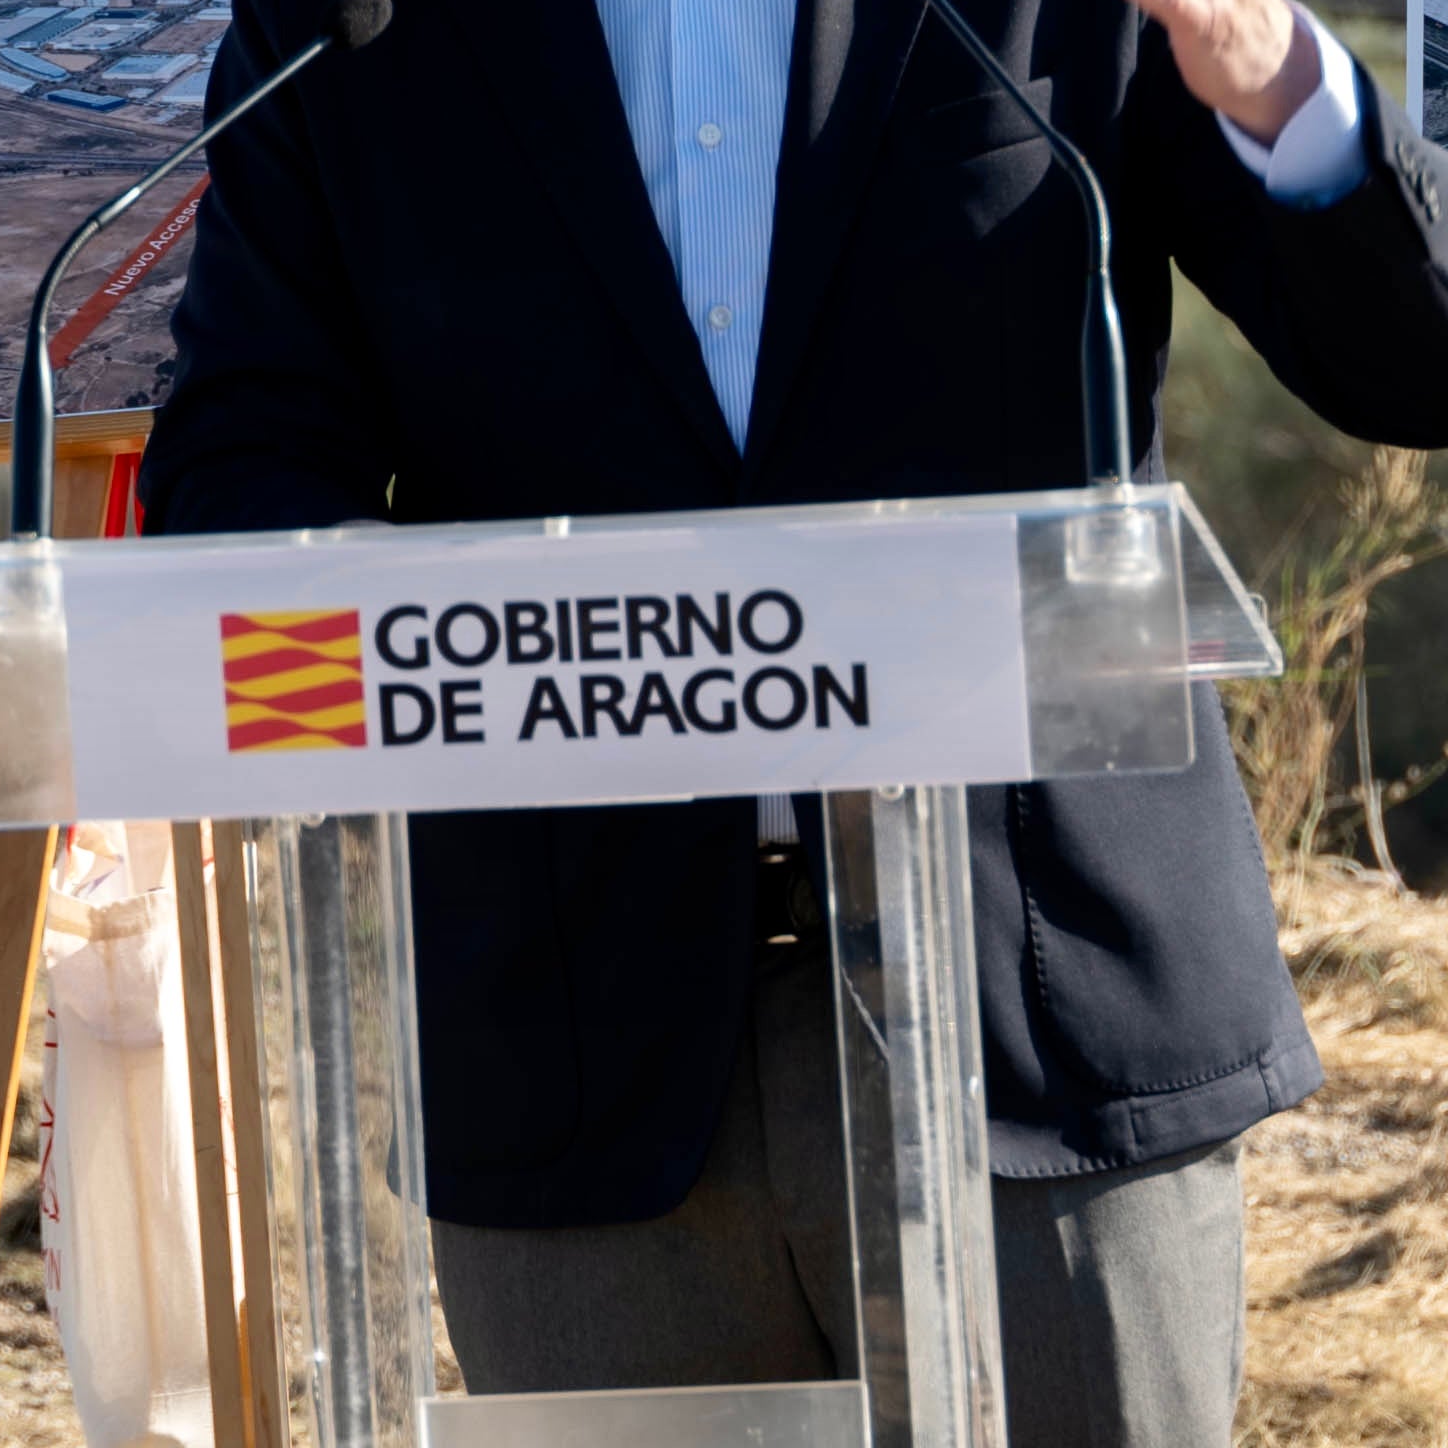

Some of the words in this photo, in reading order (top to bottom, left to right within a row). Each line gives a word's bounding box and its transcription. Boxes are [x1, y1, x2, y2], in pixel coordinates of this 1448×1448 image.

[104, 251, 155, 296] Nuevo
[150, 199, 201, 251] Acceso
[375, 589, 804, 670] GOBIERNO
[378, 678, 486, 747] DE
[518, 663, 870, 741] ARAGON
